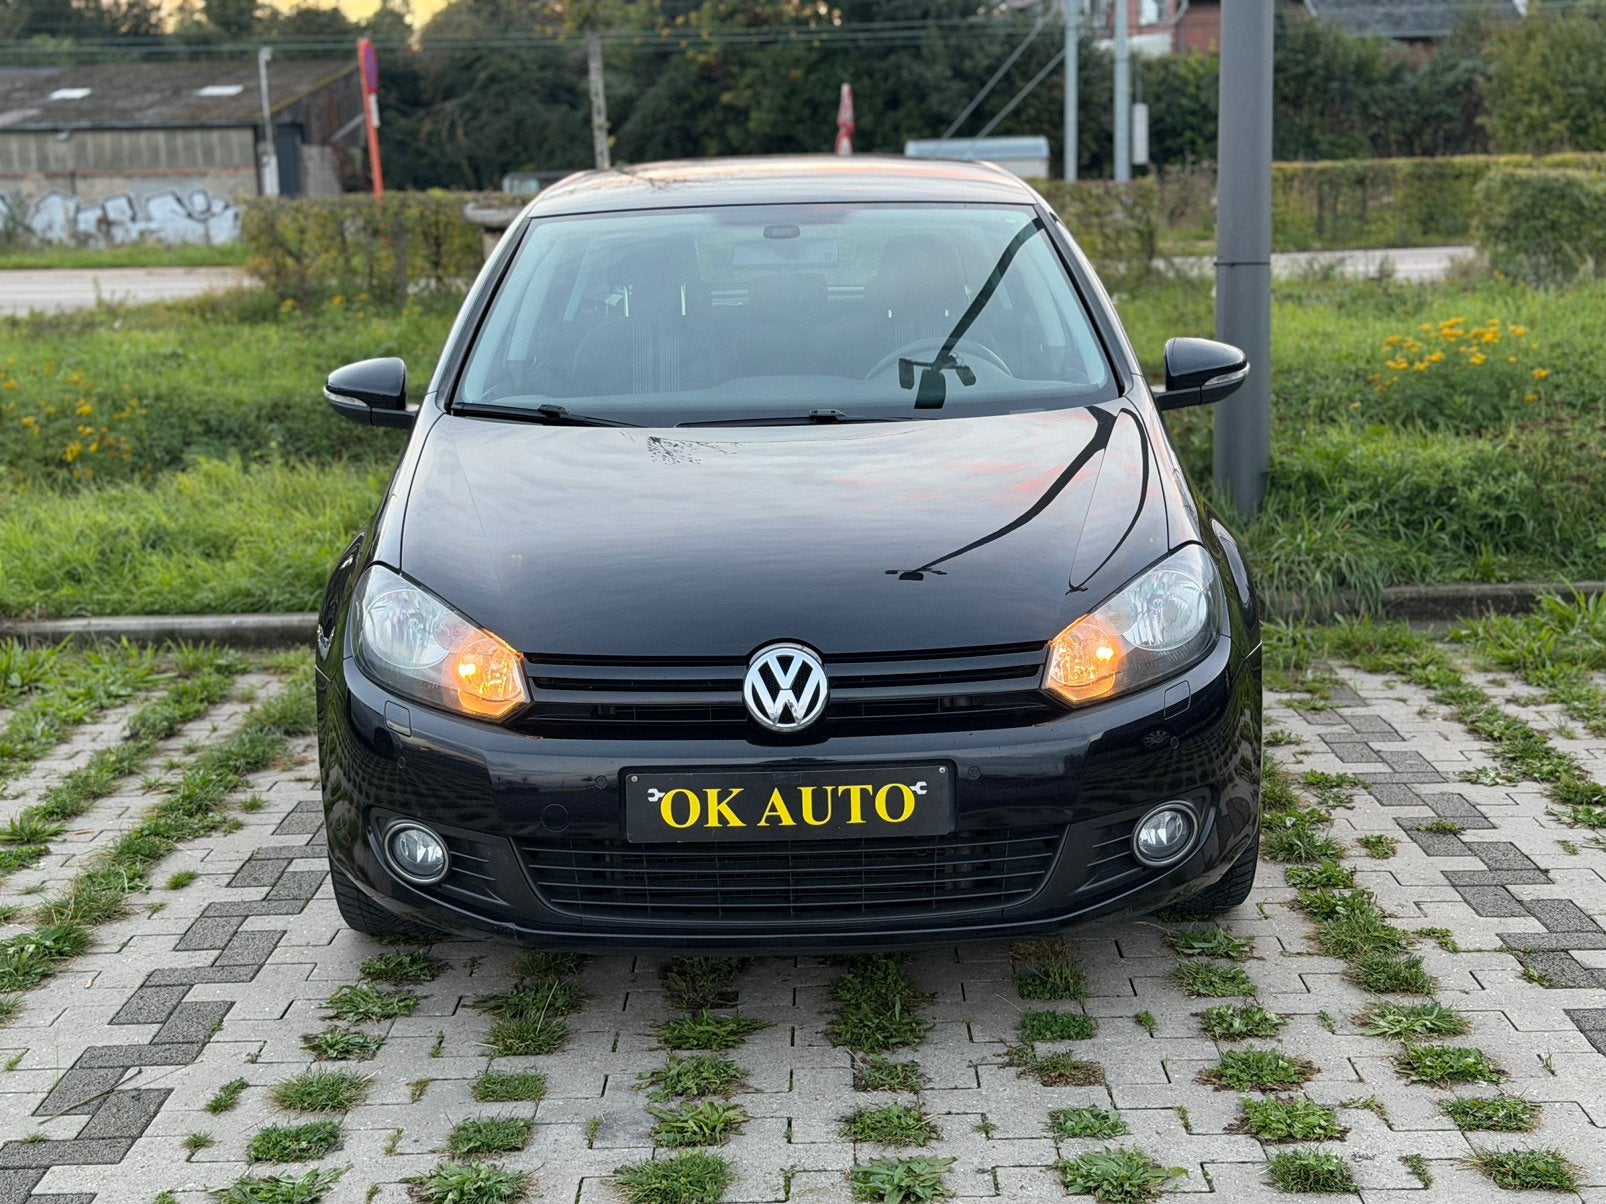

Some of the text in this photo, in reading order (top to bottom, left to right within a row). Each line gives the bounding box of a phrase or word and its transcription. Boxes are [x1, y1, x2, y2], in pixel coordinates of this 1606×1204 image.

[747, 650, 826, 728] VW
[660, 782, 916, 828] OK AUTO
